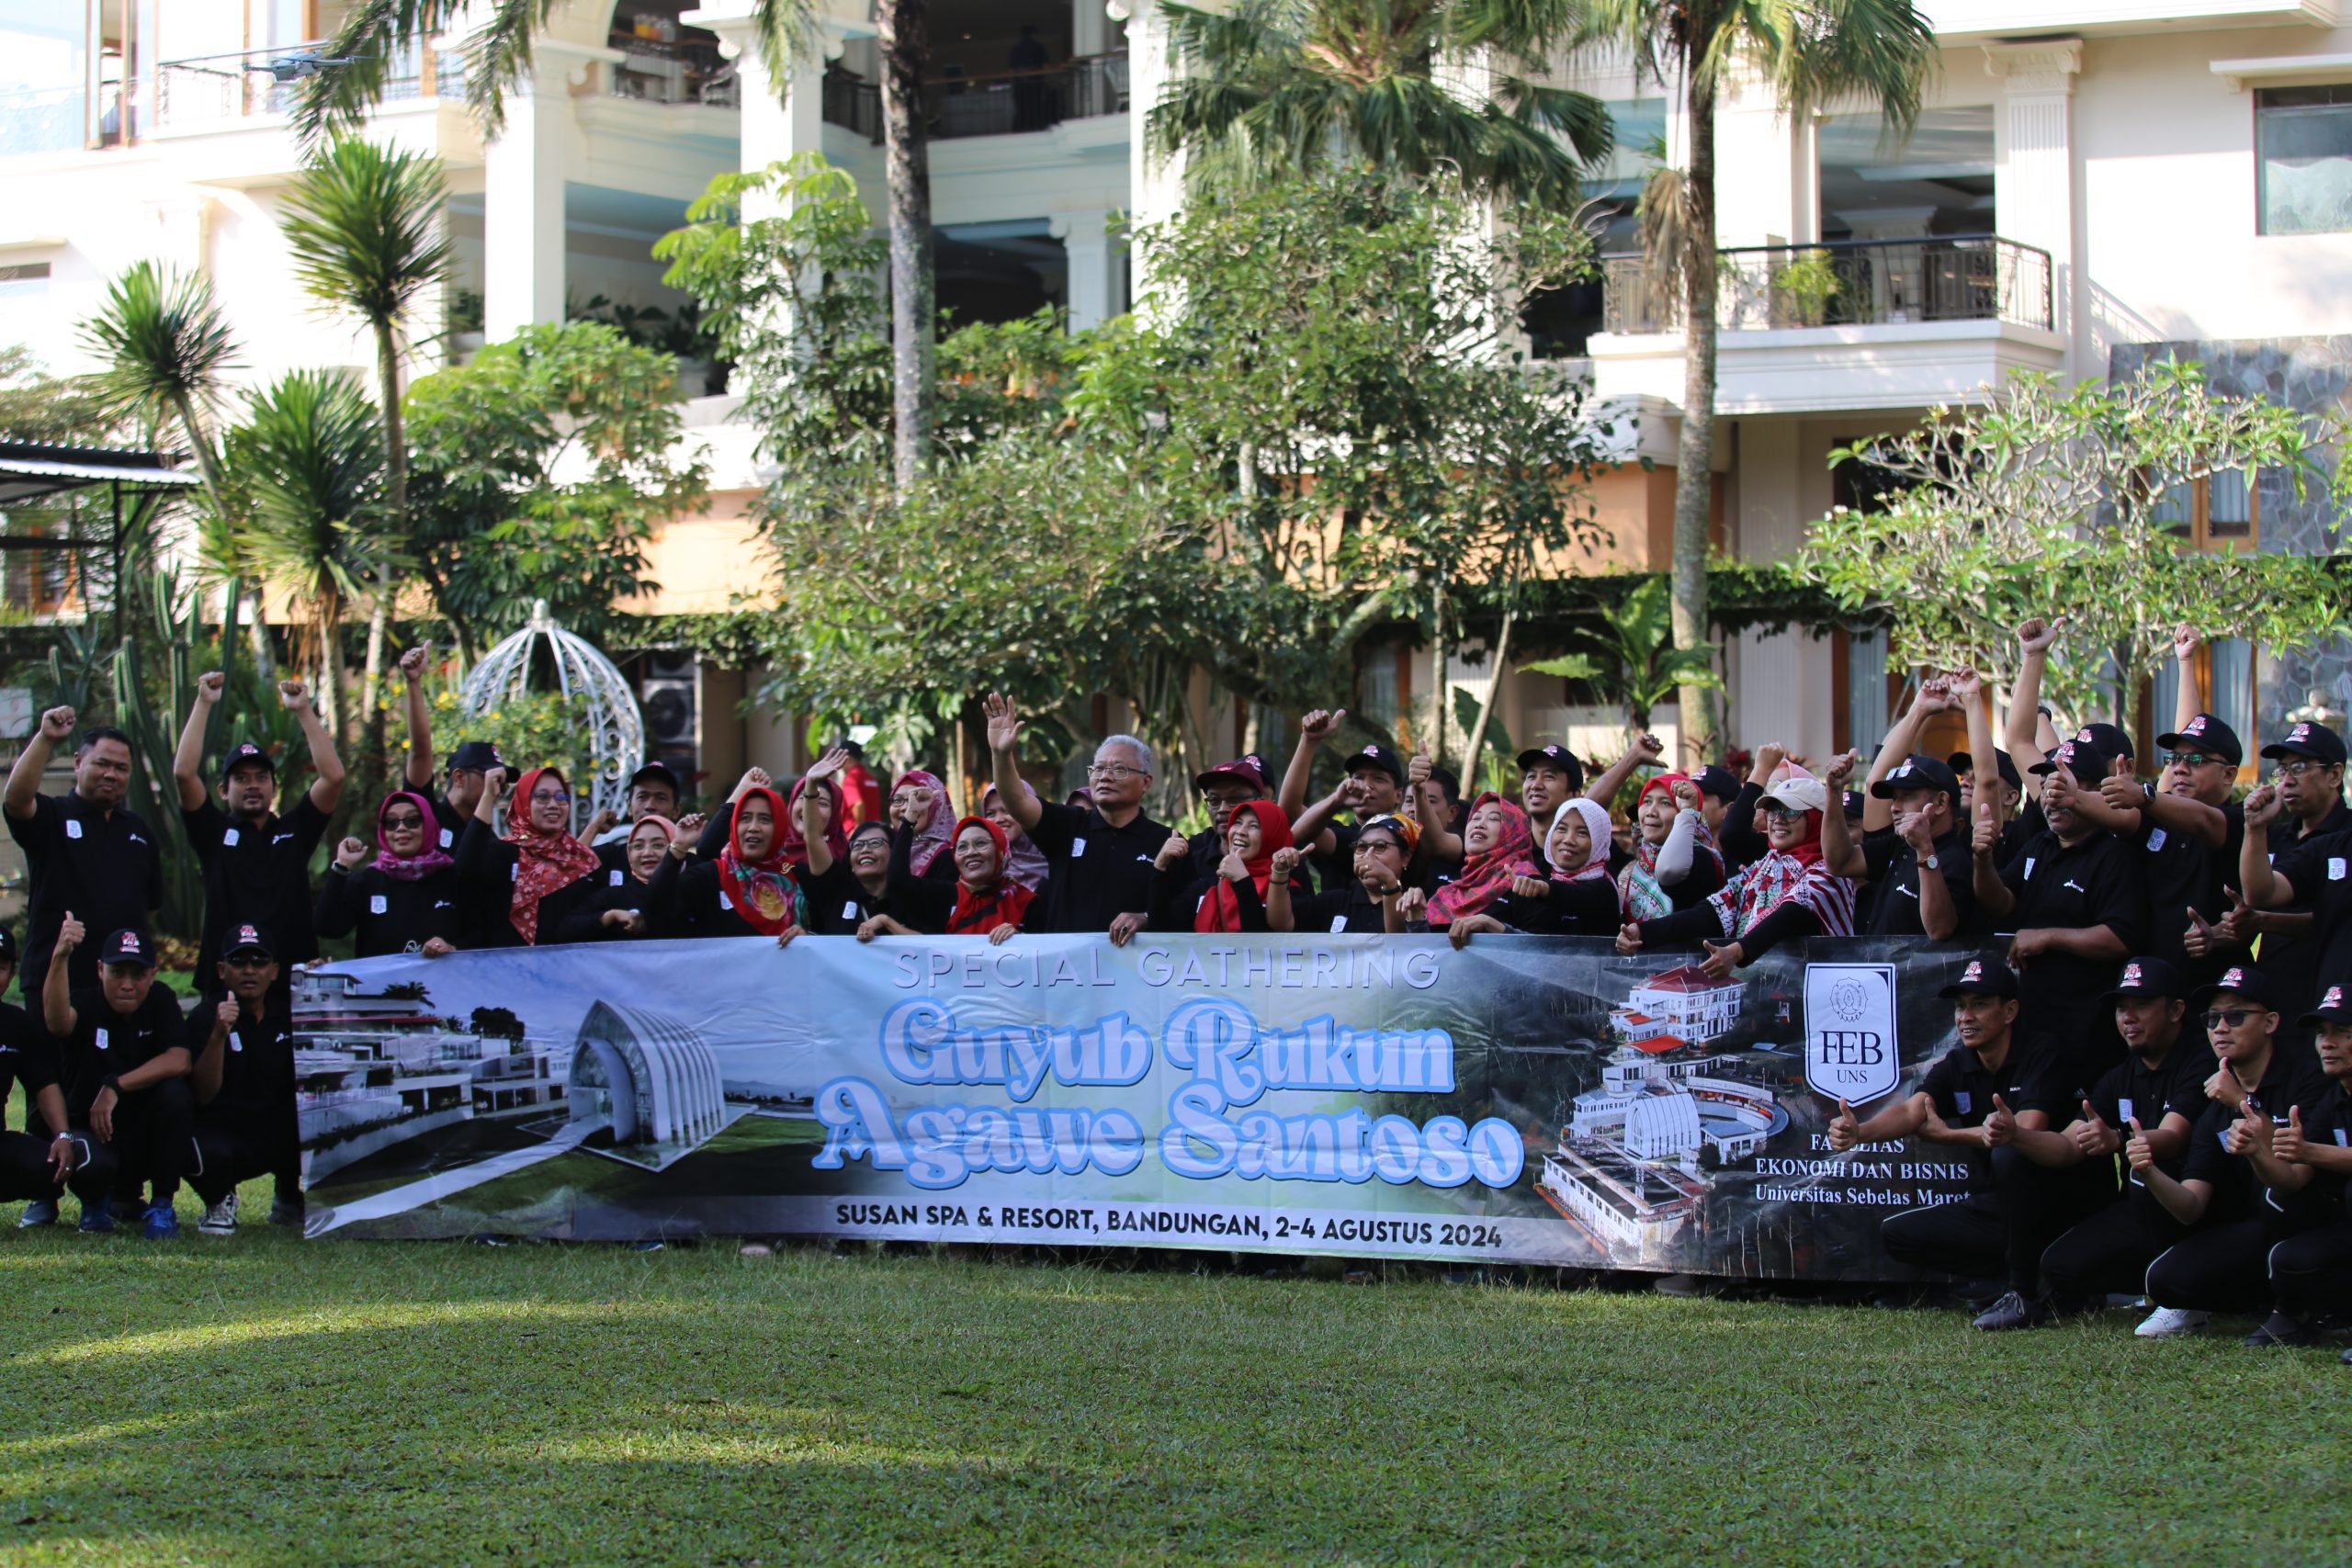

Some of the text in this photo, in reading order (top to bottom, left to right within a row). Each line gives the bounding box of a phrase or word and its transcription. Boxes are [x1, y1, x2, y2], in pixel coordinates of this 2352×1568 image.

[892, 946, 1441, 989] SPECIAL GATHERING
[879, 996, 1455, 1107] Guyub Rukun
[1819, 1030, 1883, 1065] FEB
[1837, 1069, 1868, 1084] UNS
[812, 1076, 1525, 1190] Agawe Santoso
[1756, 1157, 1970, 1180] EKONOMI DAN BISNIS
[1756, 1184, 1842, 1203] Universitas
[1847, 1188, 1910, 1205] Sebelas
[836, 1204, 1503, 1248] SUSAN SPA & RESORT, BANDUNGAN, 2-4 AGUSTUS 2024
